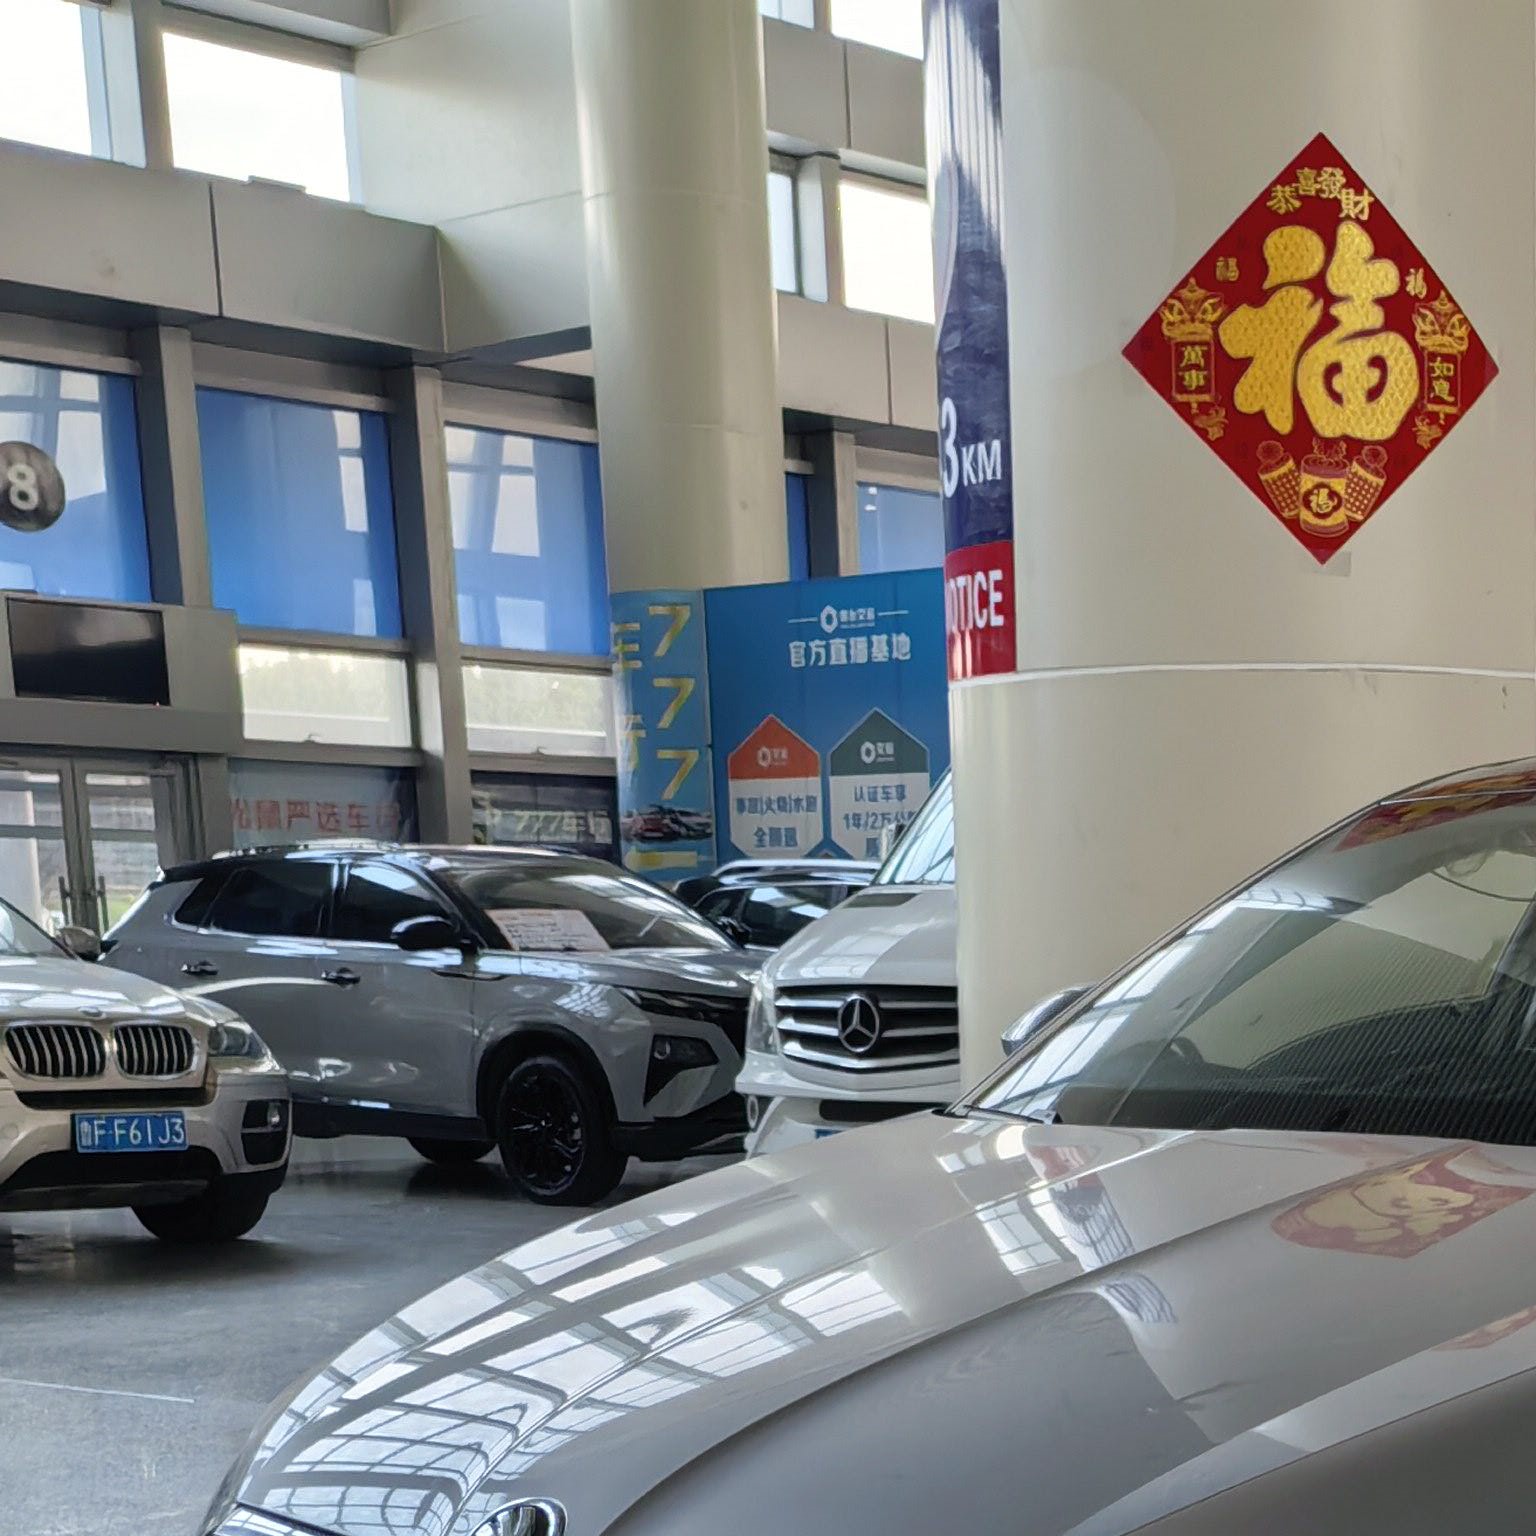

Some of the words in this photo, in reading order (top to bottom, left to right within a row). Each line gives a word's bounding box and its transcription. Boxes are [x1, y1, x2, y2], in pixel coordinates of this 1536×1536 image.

[1267, 167, 1374, 220] 恭喜發財
[1218, 221, 1420, 440] 福
[1180, 344, 1207, 391] 萬事
[1428, 356, 1455, 403] 如意
[1308, 487, 1338, 514] 福
[788, 632, 912, 668] 官方直播基地
